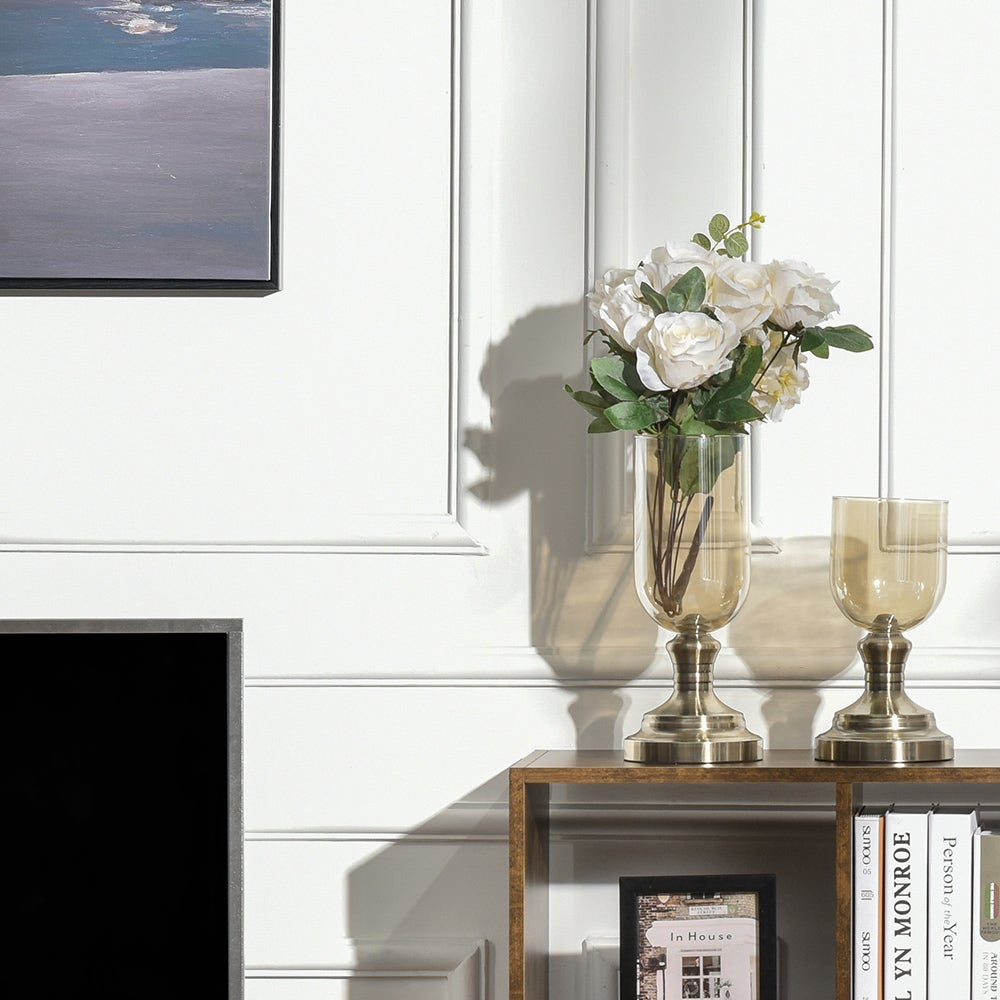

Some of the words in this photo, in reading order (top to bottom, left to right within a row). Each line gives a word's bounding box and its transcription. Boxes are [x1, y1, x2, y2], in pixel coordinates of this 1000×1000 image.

[893, 832, 912, 937] MONROE
[943, 837, 957, 894] Person
[942, 896, 952, 907] of
[670, 932, 683, 942] In
[688, 932, 733, 941] House
[943, 922, 957, 960] Year
[894, 947, 912, 981] YN
[990, 952, 998, 992] AROUND
